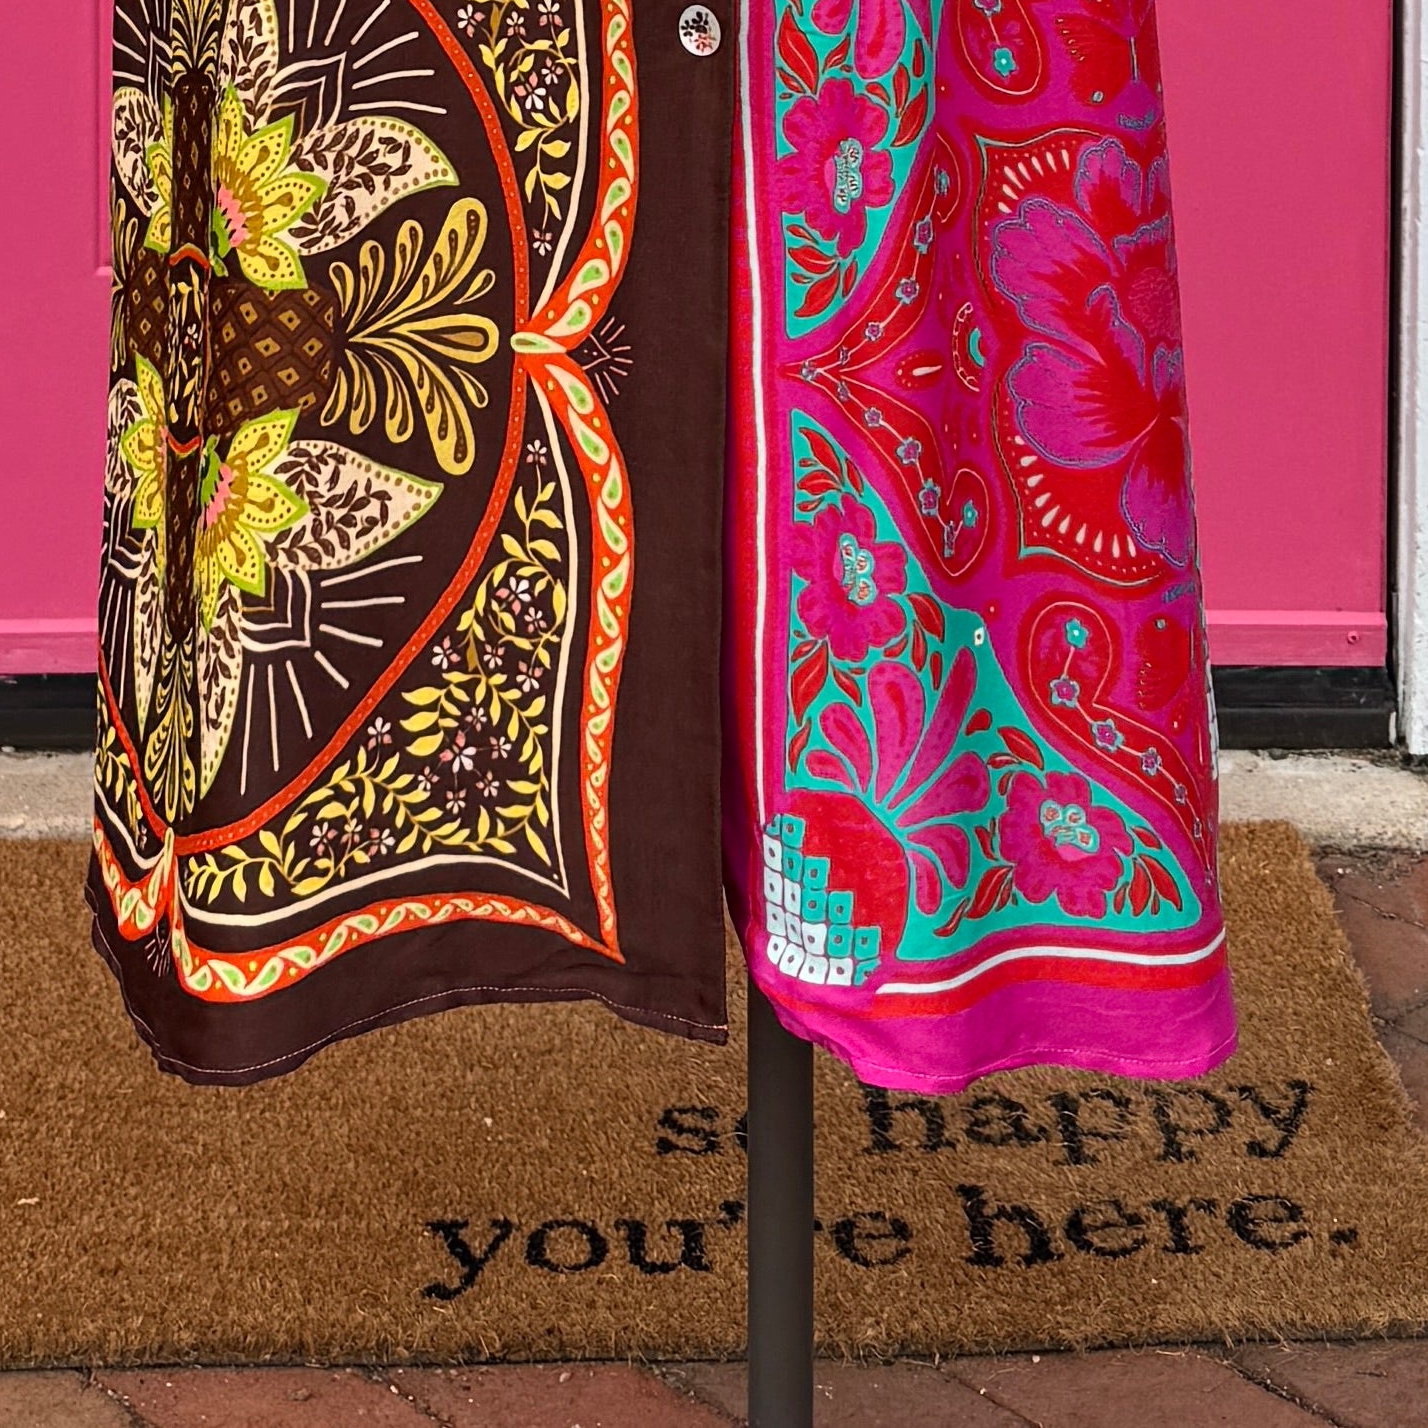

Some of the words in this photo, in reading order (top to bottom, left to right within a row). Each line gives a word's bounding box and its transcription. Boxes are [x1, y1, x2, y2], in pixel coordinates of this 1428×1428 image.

[862, 1079, 1316, 1166] happy
[422, 1199, 914, 1301] you'e
[955, 1183, 1359, 1268] here.
